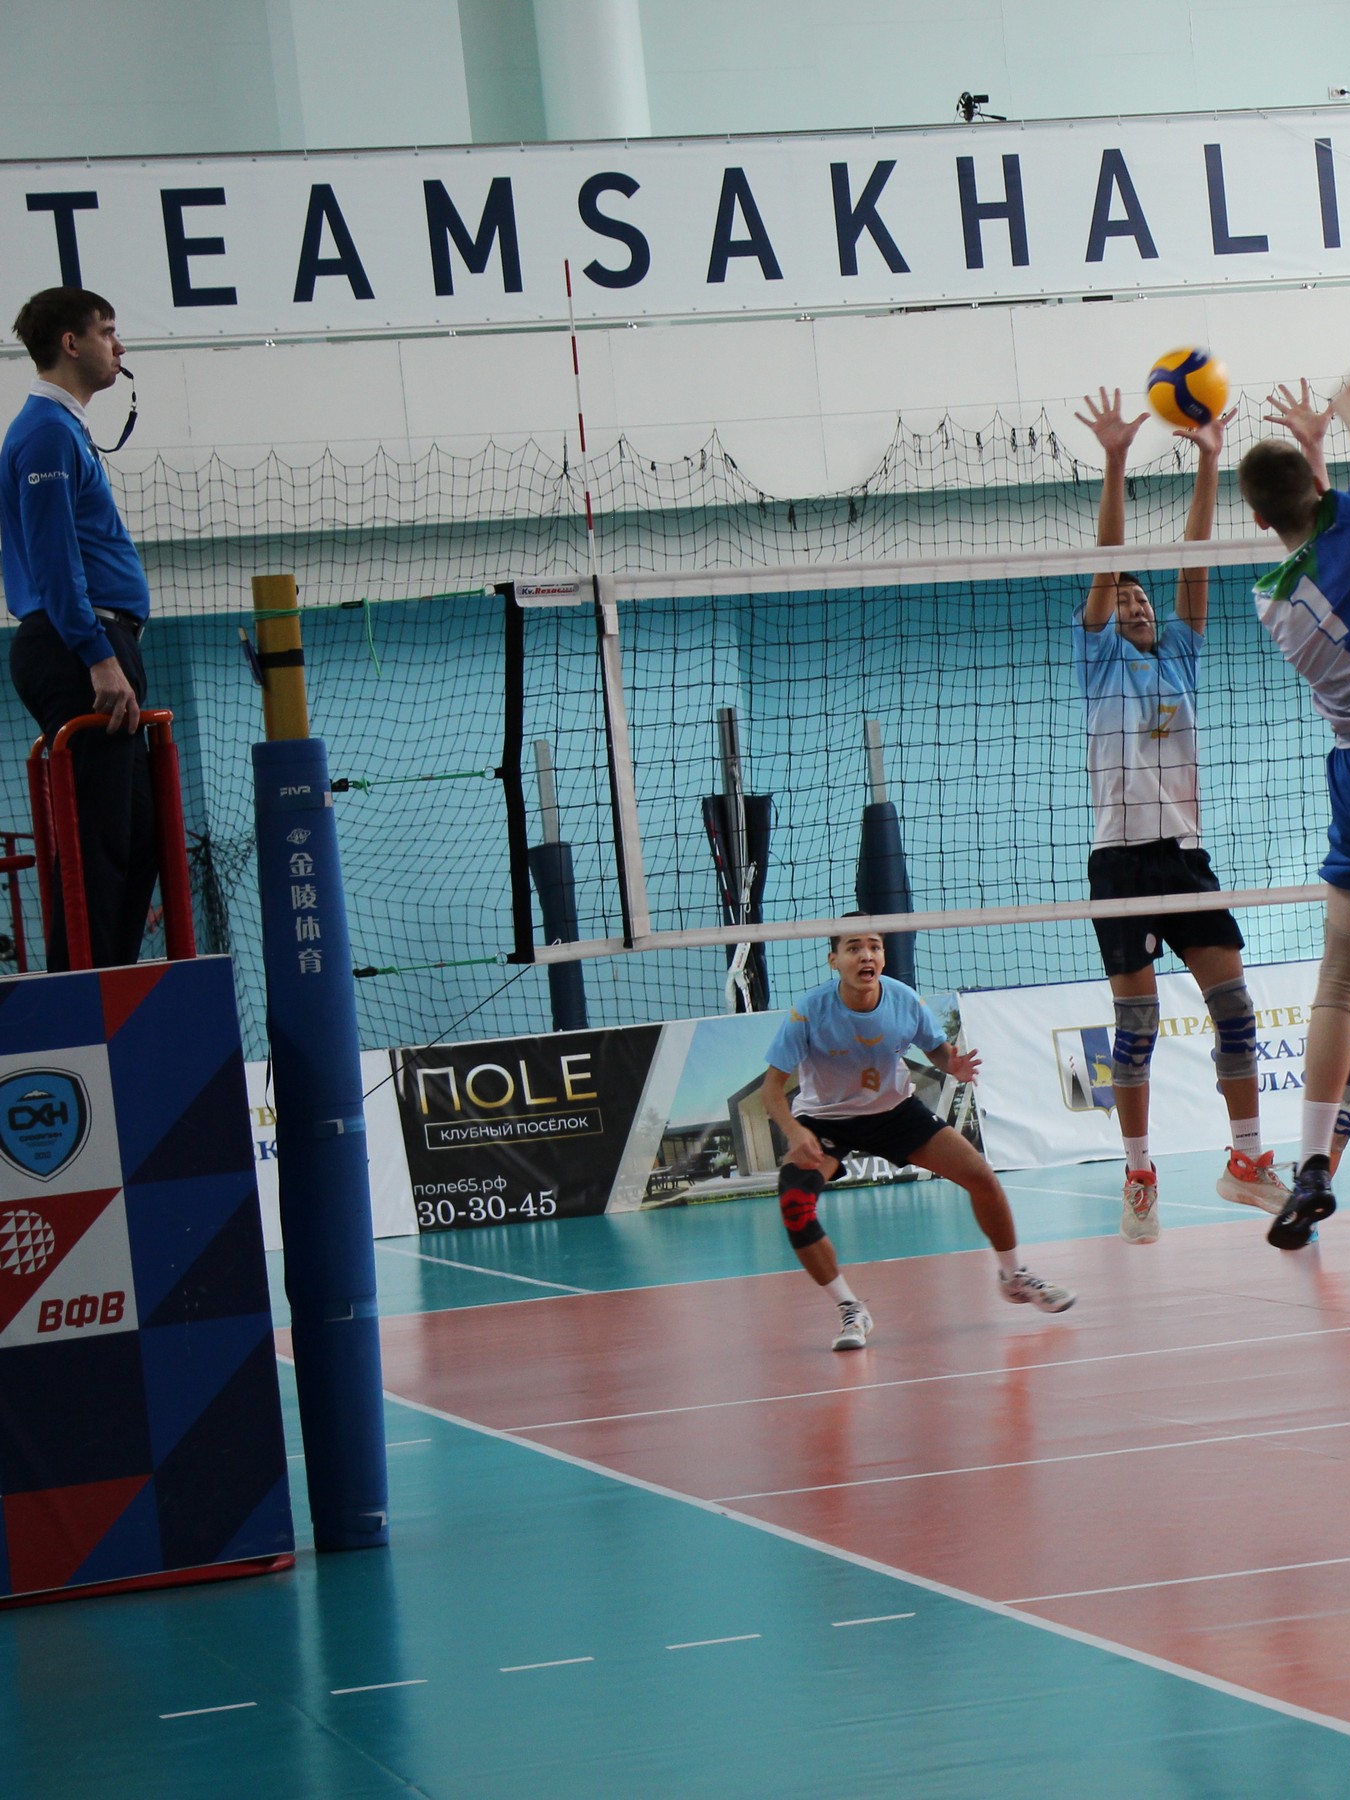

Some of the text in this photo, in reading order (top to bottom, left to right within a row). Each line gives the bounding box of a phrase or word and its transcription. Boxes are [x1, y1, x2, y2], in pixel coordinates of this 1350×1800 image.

[289, 852, 323, 975] 金陵体育
[441, 1116, 589, 1141] КЛУБНЫЙ ПОСЁЛОК
[417, 1190, 557, 1226] 30-30-45
[37, 1290, 126, 1334] ВФВ
